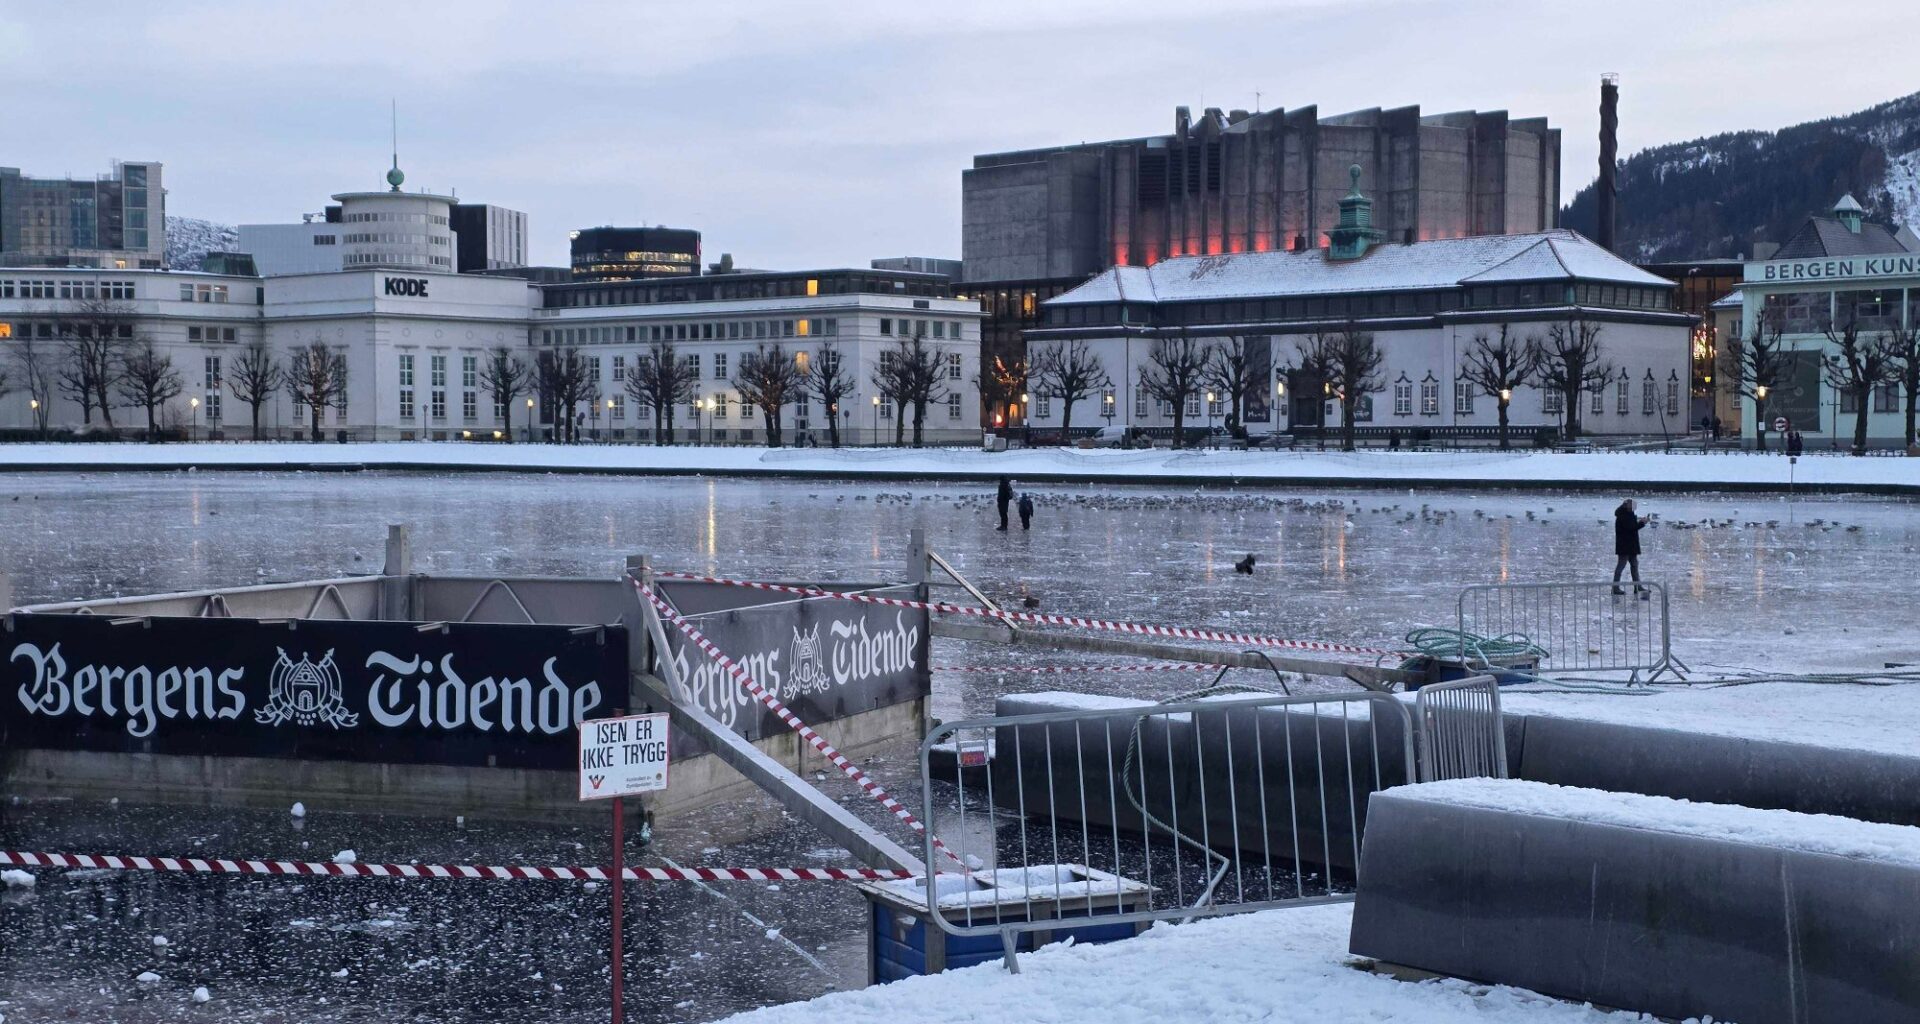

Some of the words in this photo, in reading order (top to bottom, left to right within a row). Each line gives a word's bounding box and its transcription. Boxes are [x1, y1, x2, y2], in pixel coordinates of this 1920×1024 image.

[1765, 261, 1853, 280] BERGEN
[1866, 257, 1920, 275] KUN
[384, 276, 429, 297] KODE
[830, 609, 918, 685] Tidende
[10, 642, 246, 737] Bergens
[366, 650, 602, 735] Tidende
[597, 721, 627, 744] ISEN
[636, 719, 652, 740] ER
[583, 746, 614, 769] IKKE
[622, 741, 667, 765] TRYGG
